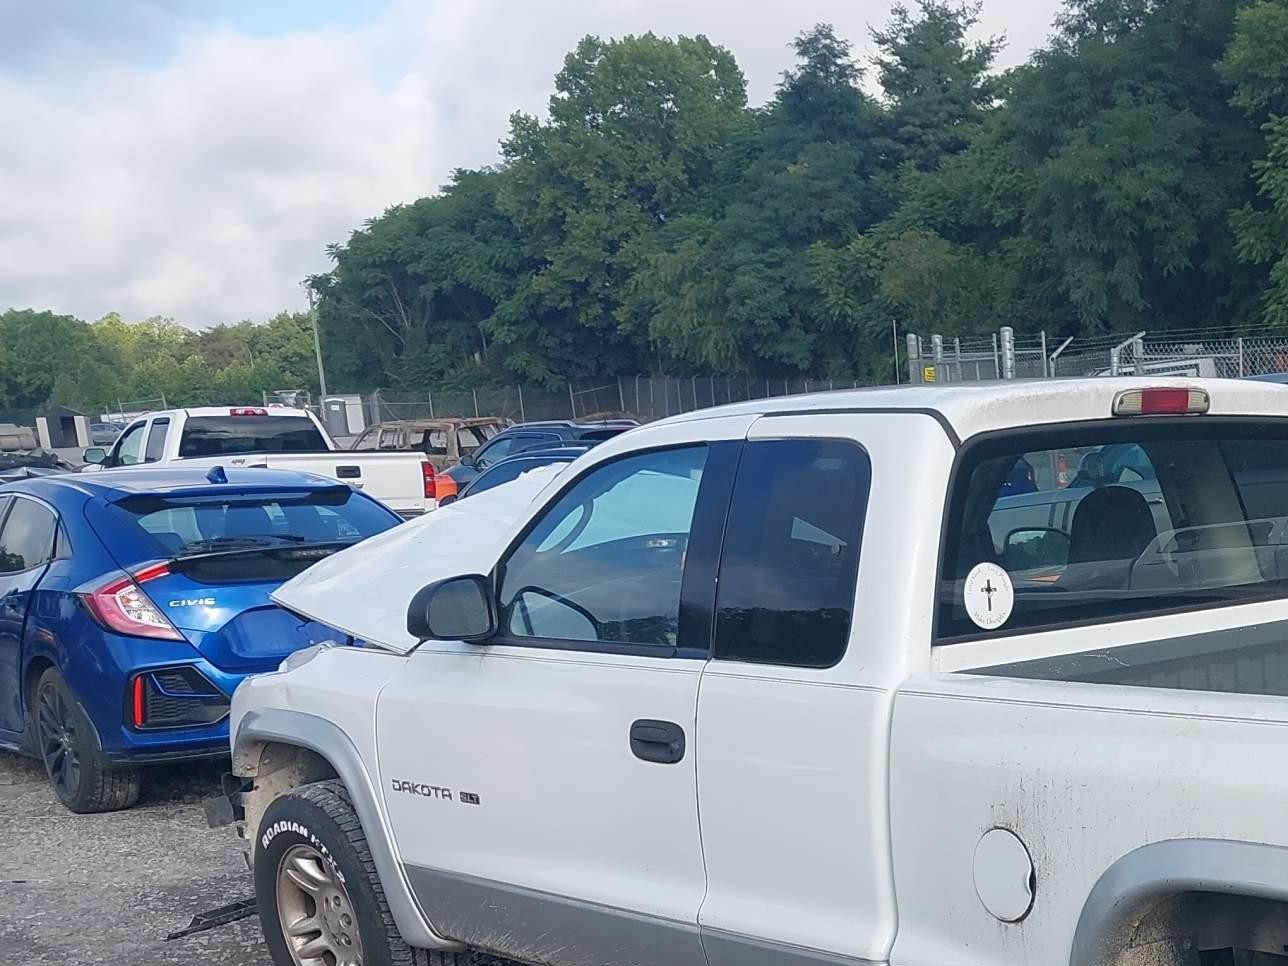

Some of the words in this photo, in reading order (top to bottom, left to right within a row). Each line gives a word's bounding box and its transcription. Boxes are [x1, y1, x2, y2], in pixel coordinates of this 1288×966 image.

[169, 598, 216, 607] CIVIC
[392, 779, 452, 800] DAKOTA
[261, 820, 308, 850] ROADIAN
